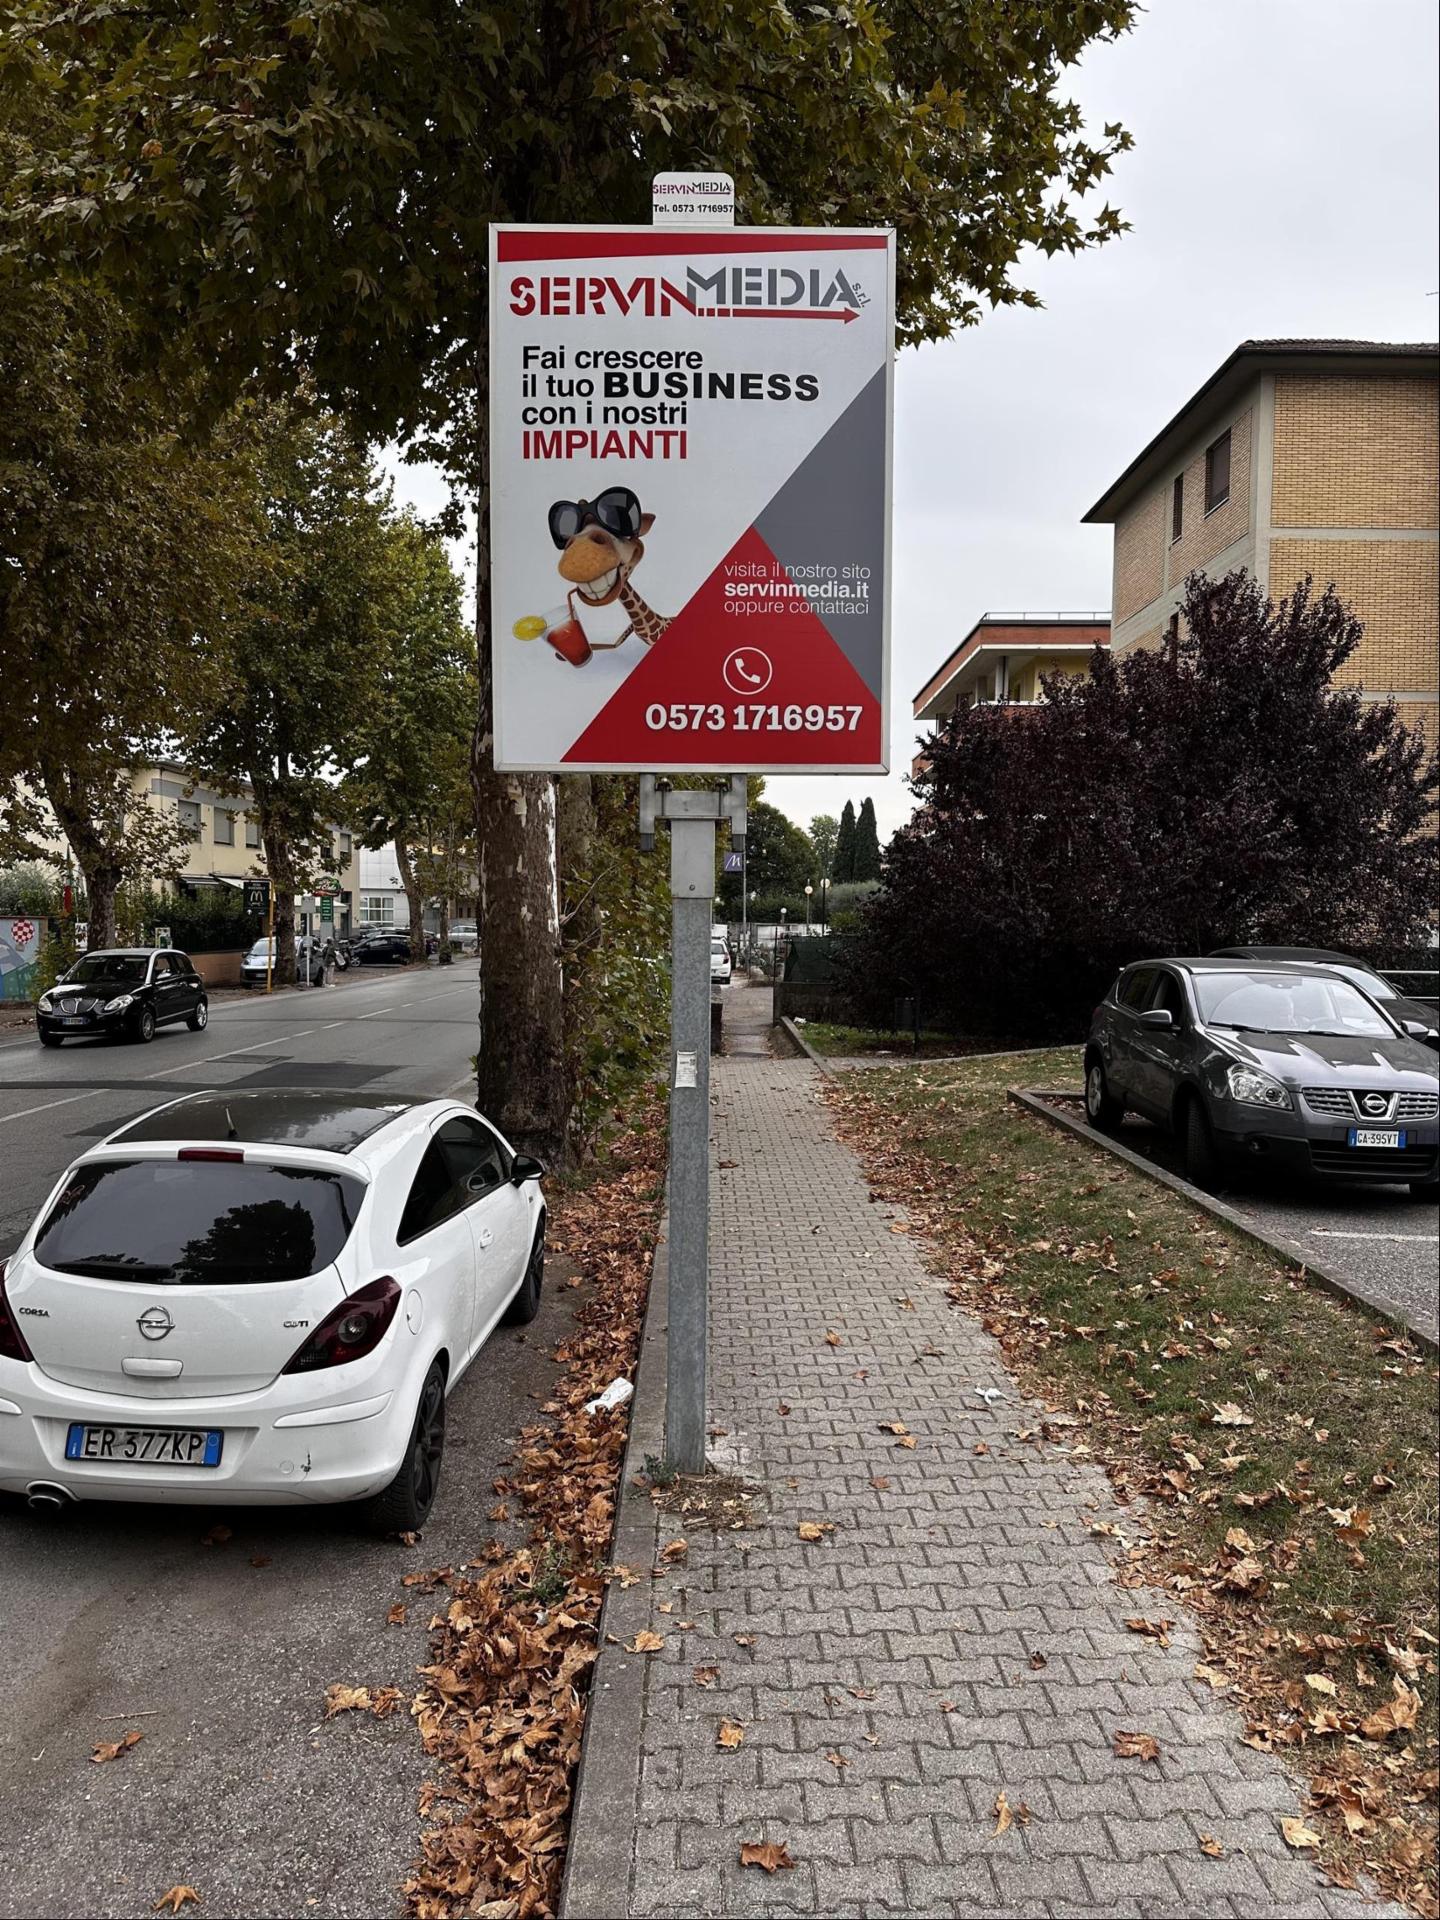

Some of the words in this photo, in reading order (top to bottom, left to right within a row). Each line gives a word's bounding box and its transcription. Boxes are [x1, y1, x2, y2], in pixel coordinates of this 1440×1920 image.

[653, 204, 670, 213] Tel.
[672, 204, 695, 213] 0573
[697, 204, 734, 213] 1716957
[522, 345, 565, 370] Fai
[574, 350, 703, 370] crescere
[522, 374, 537, 397] il
[546, 375, 595, 398] tuo
[603, 371, 819, 401] BUSINESS
[521, 405, 576, 425] con
[586, 401, 593, 424] i
[602, 401, 687, 425] nostri
[522, 430, 687, 459] IMPIANTI
[724, 562, 767, 577] visita
[772, 562, 780, 577] il
[785, 563, 837, 578] nostro
[842, 563, 871, 579] sito
[724, 580, 869, 598] servinmedia.it
[724, 601, 784, 616] oppure
[789, 600, 869, 614] contattaci
[645, 704, 725, 731] 0573
[733, 705, 863, 731] 1716957
[19, 1307, 50, 1317] CORSA
[84, 1429, 116, 1457] ER
[124, 1431, 204, 1461] 377KP
